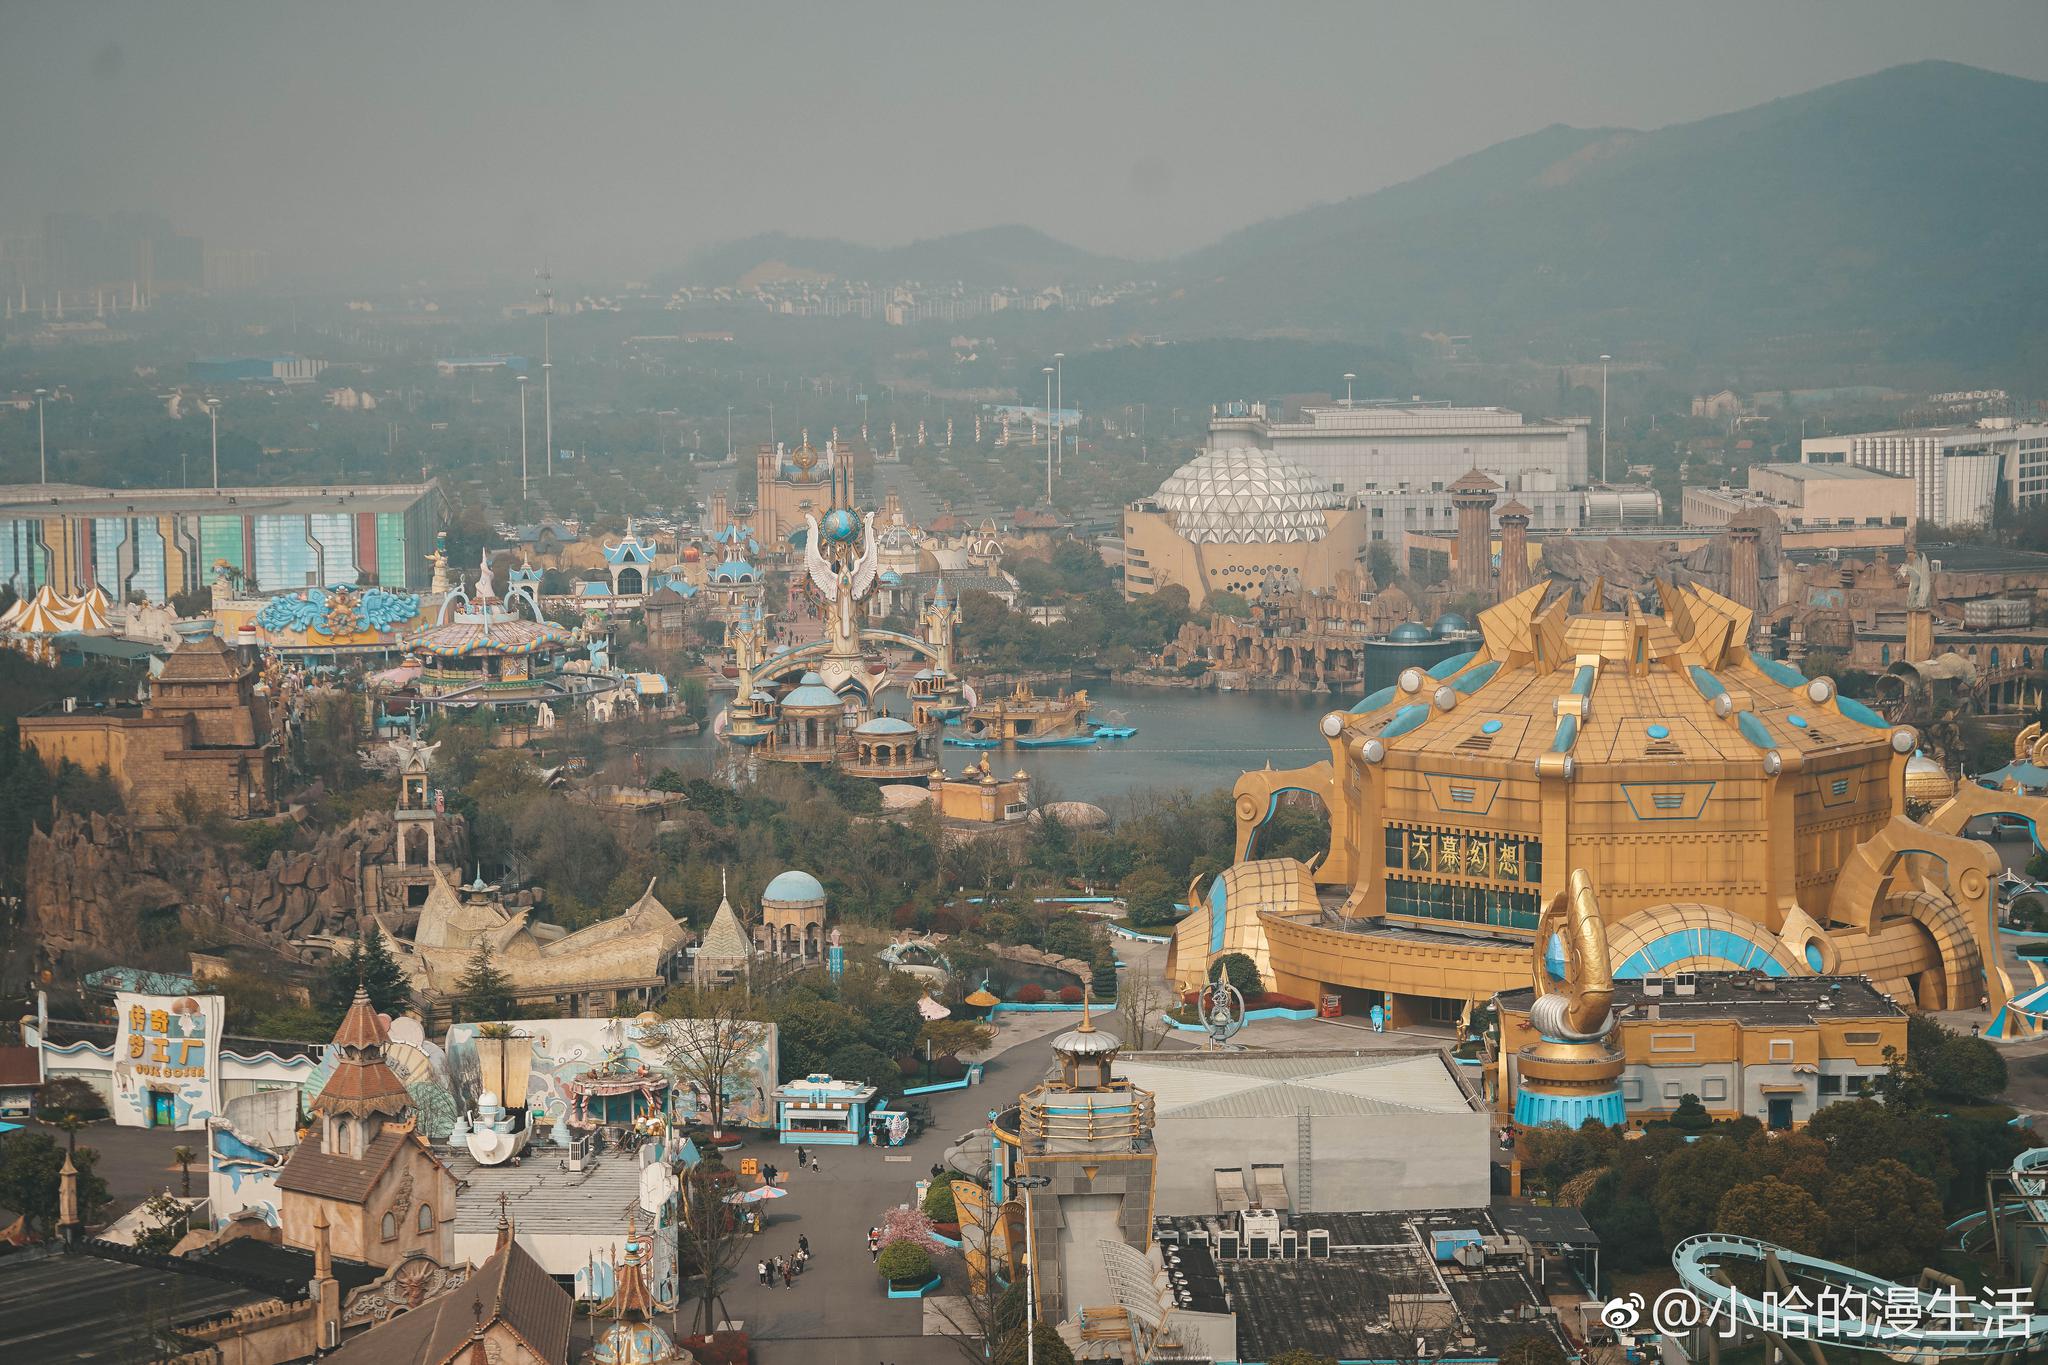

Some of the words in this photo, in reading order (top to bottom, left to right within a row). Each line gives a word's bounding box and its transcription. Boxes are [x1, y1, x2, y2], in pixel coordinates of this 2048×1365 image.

[1411, 832, 1519, 876] 天幕幻想
[129, 1004, 169, 1034] 传奇
[128, 1034, 205, 1065] 梦工厂
